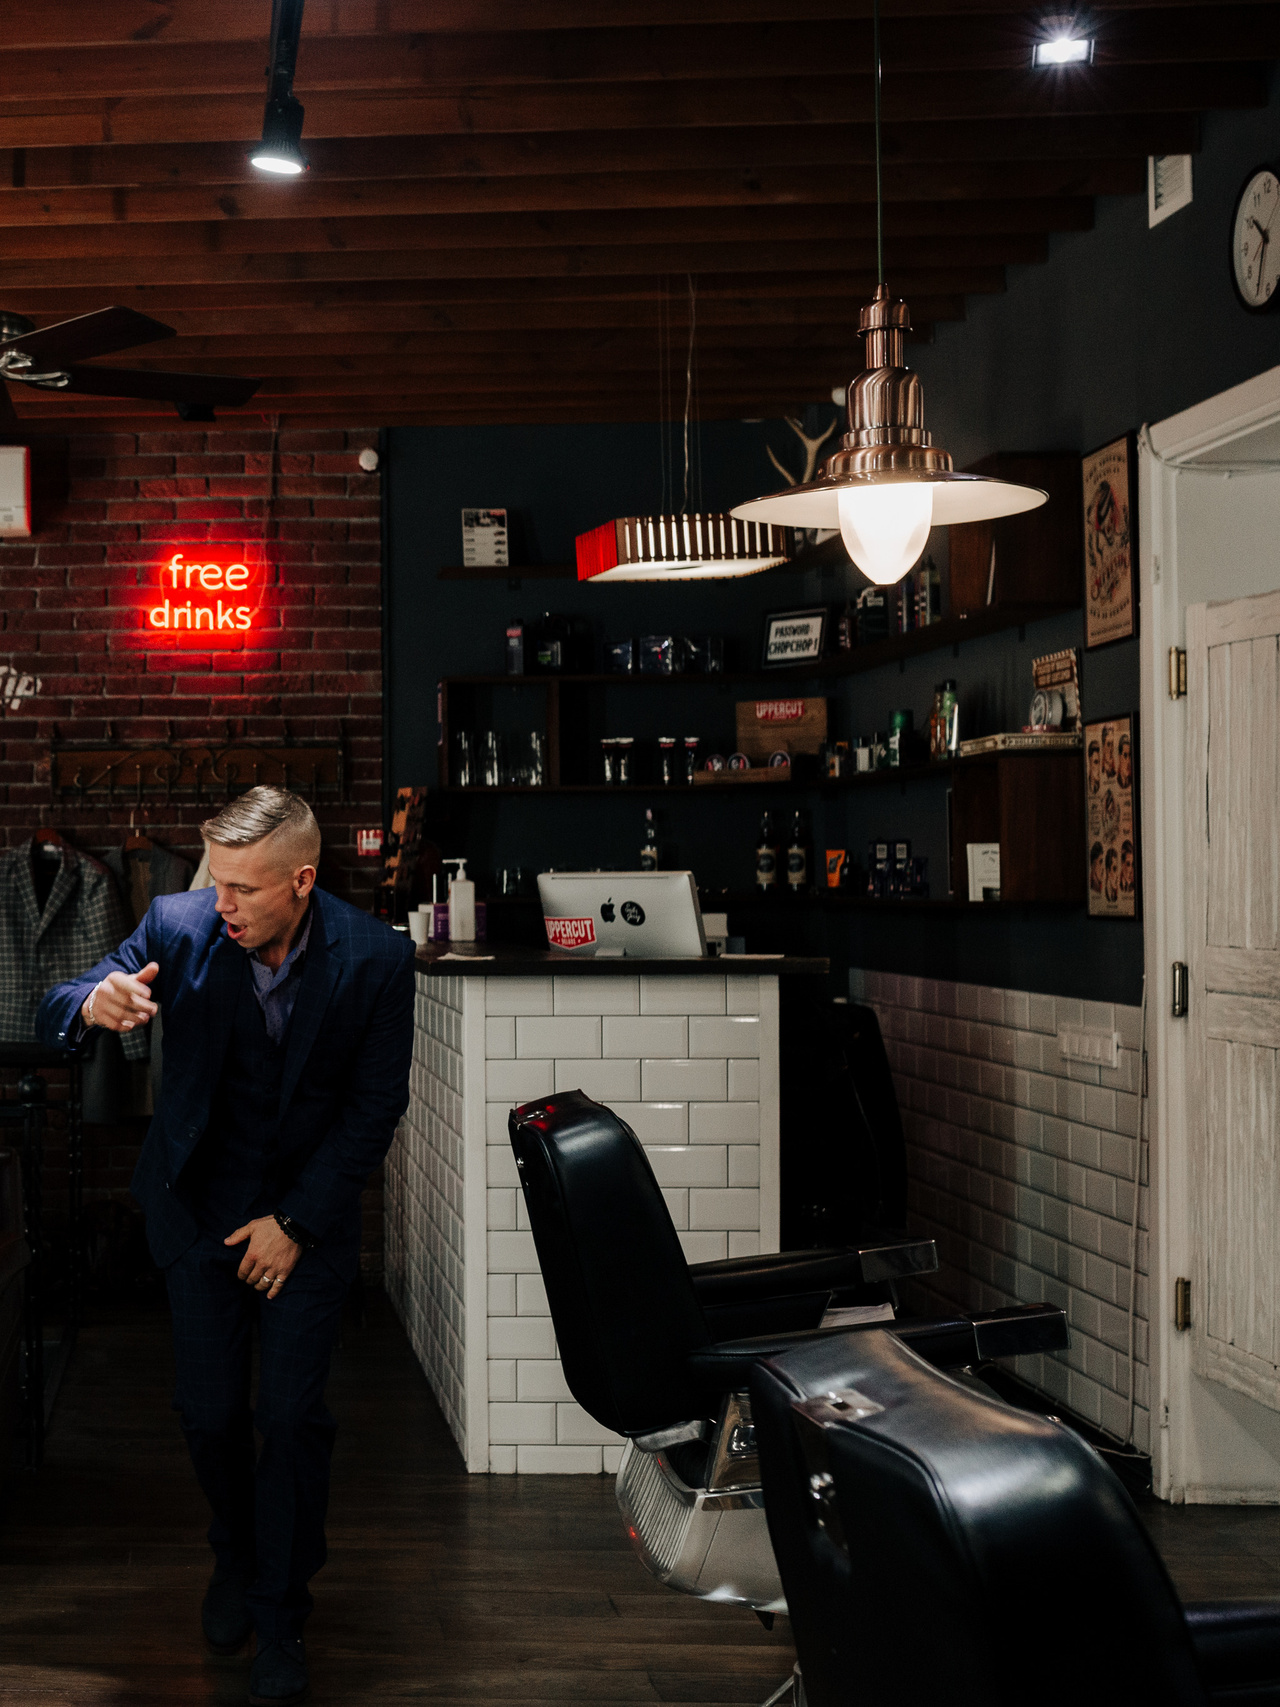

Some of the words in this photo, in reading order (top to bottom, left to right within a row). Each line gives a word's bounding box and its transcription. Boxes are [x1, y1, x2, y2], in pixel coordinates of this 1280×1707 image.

[1263, 179, 1271, 194] 12
[1253, 193, 1261, 207] 11
[168, 553, 249, 591] free
[149, 598, 252, 631] drinks
[755, 699, 804, 719] UPPERCUT
[547, 919, 592, 941] UPPERCUT
